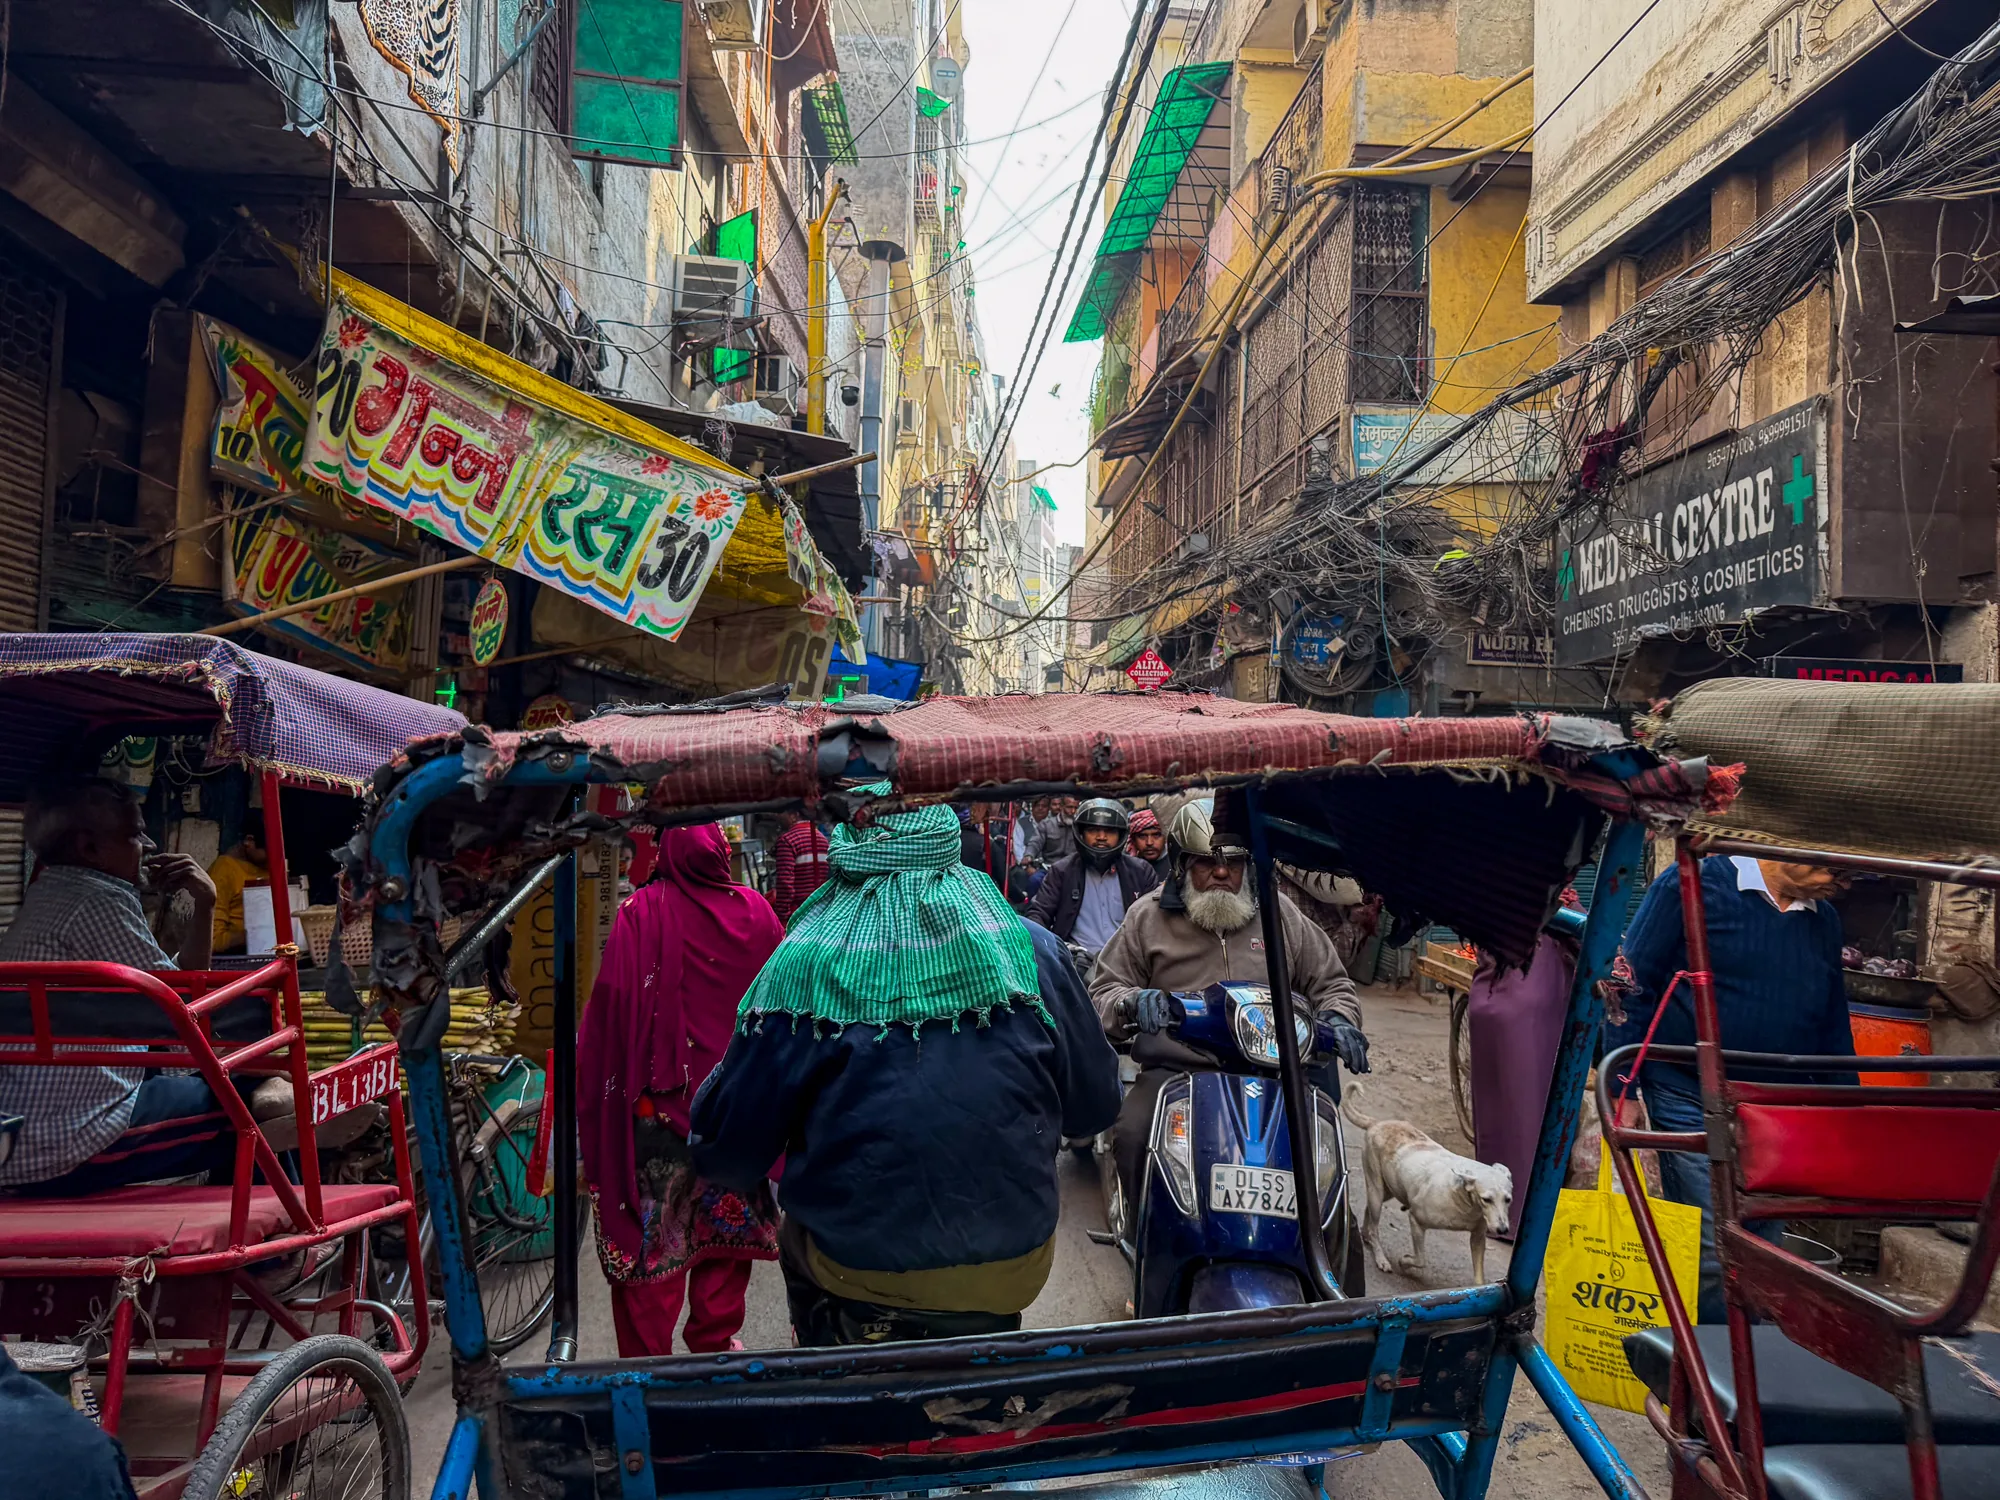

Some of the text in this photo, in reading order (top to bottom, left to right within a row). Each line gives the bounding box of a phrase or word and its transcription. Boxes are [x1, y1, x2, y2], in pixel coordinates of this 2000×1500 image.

[541, 462, 669, 577] रस
[637, 515, 710, 603] 30
[1671, 466, 1776, 562] CENTRE
[1690, 575, 1701, 598] &
[1704, 544, 1805, 596] COSMETICES
[1135, 660, 1164, 670] ALIYA
[1222, 1189, 1296, 1215] AX7844
[1572, 1273, 1662, 1320] शंकर
